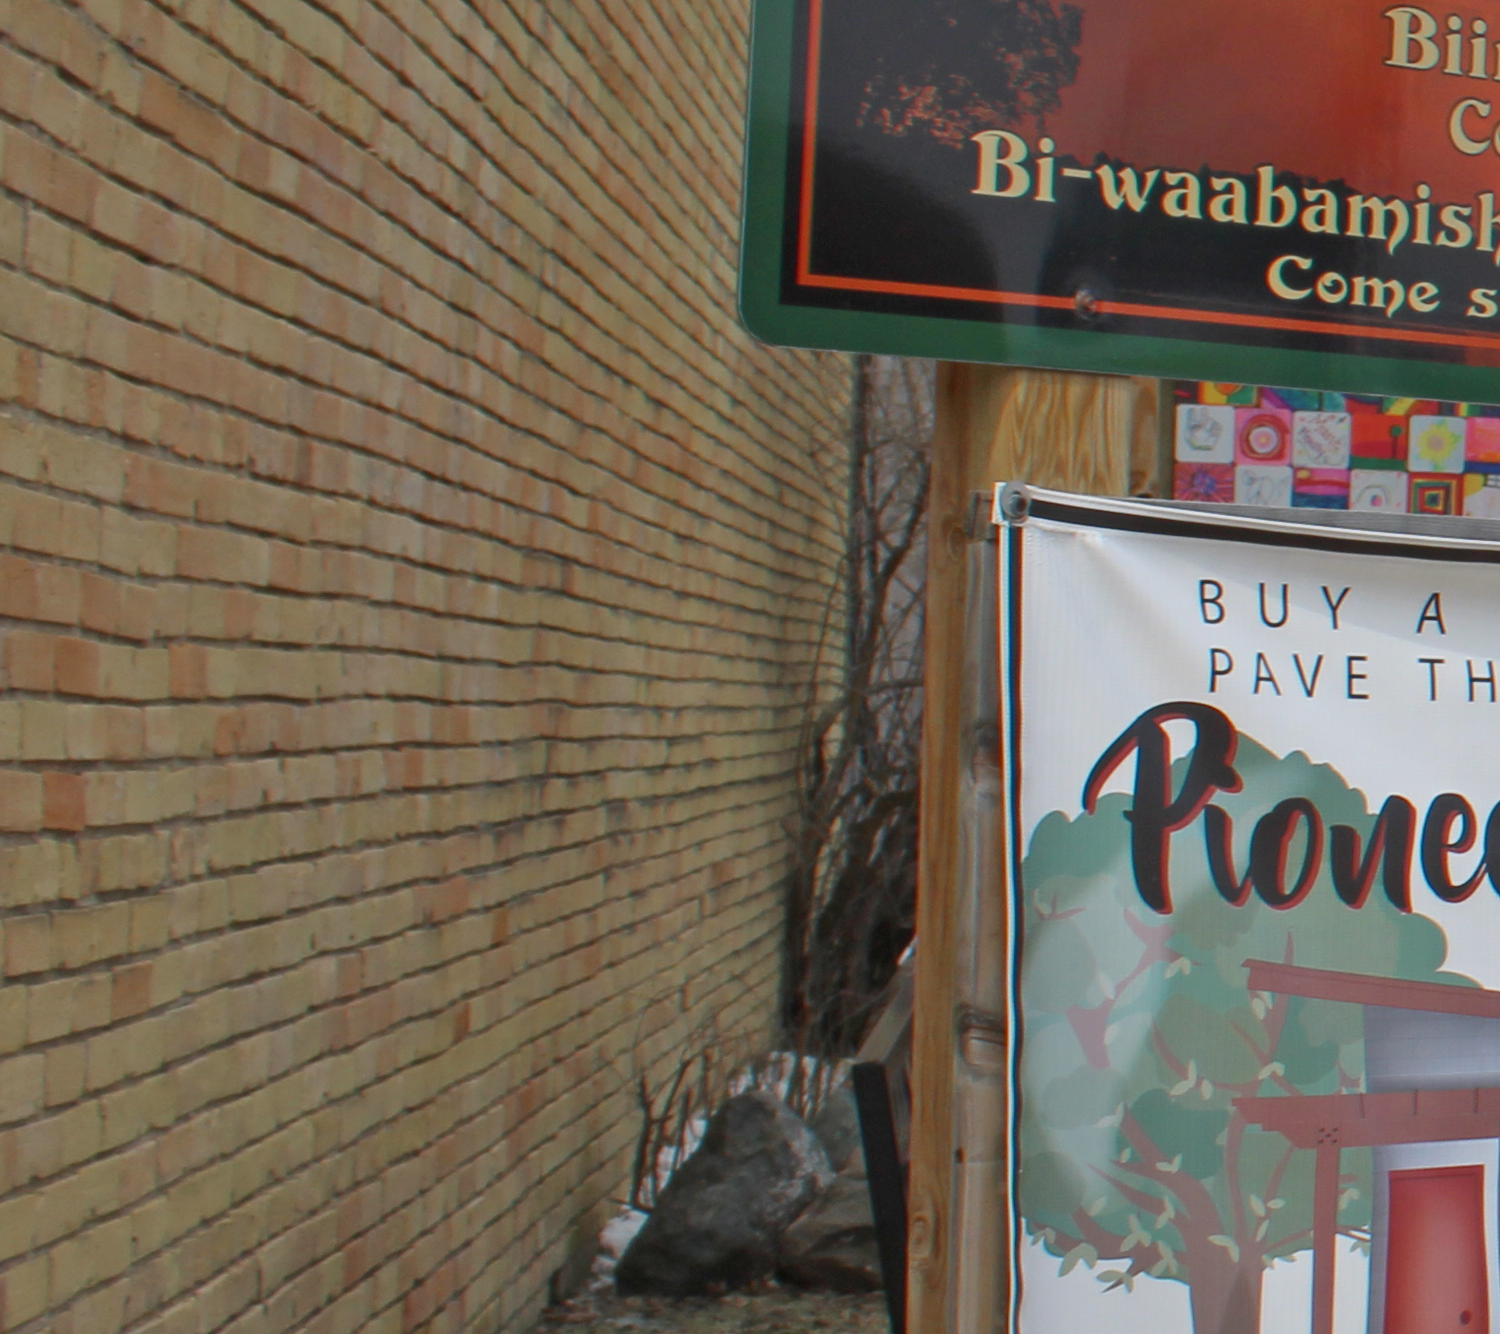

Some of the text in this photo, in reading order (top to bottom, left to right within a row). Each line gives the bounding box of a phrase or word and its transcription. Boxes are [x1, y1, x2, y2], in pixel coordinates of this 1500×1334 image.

[1266, 252, 1441, 319] Come
[1199, 578, 1352, 629] BUY
[1415, 591, 1447, 635] A
[1208, 647, 1371, 700] PAVE
